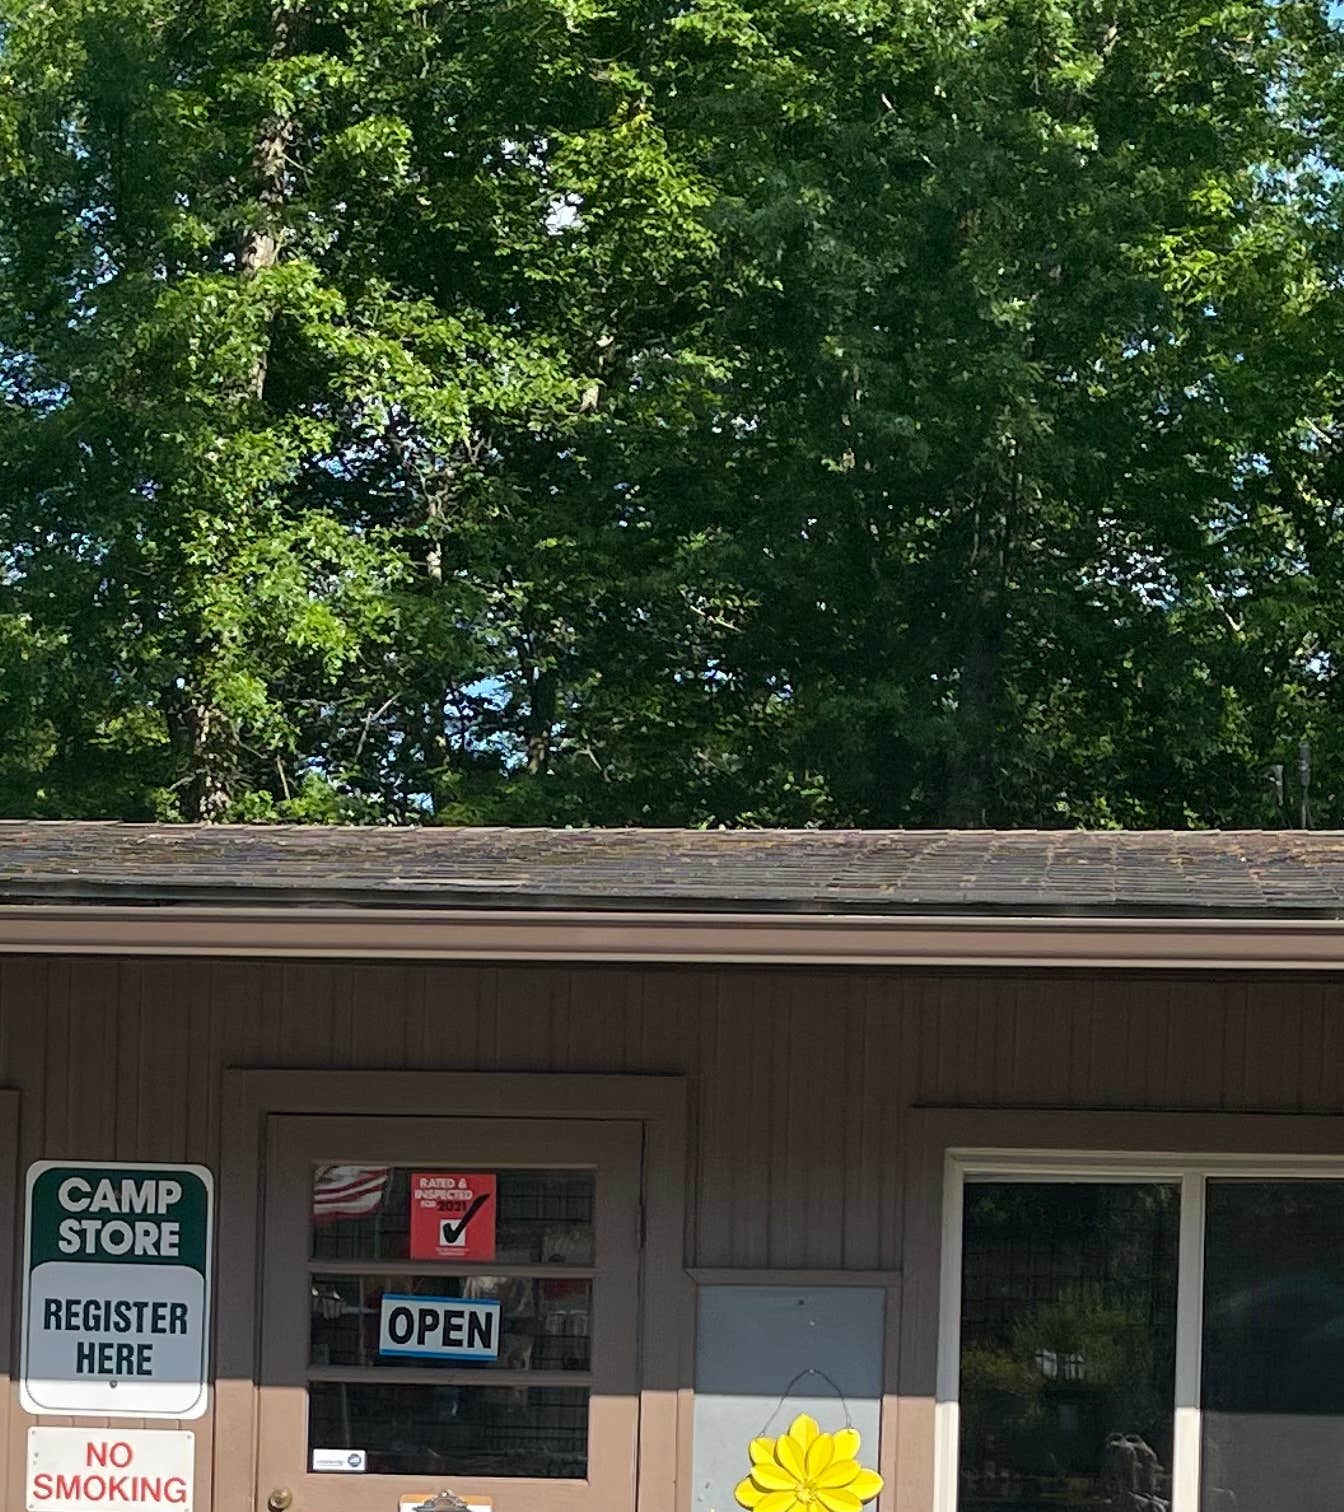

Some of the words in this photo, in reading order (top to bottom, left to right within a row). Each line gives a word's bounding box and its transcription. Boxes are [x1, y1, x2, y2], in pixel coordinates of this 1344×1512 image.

[57, 1176, 183, 1215] CAMP
[414, 1189, 474, 1201] INSPECTED
[419, 1177, 455, 1189] RATED
[457, 1177, 468, 1189] &
[57, 1218, 180, 1257] STORE
[43, 1298, 189, 1335] REGISTER
[388, 1306, 494, 1349] OPEN
[76, 1341, 154, 1376] HERE
[85, 1441, 134, 1468] NO
[32, 1473, 188, 1504] SMOKING
